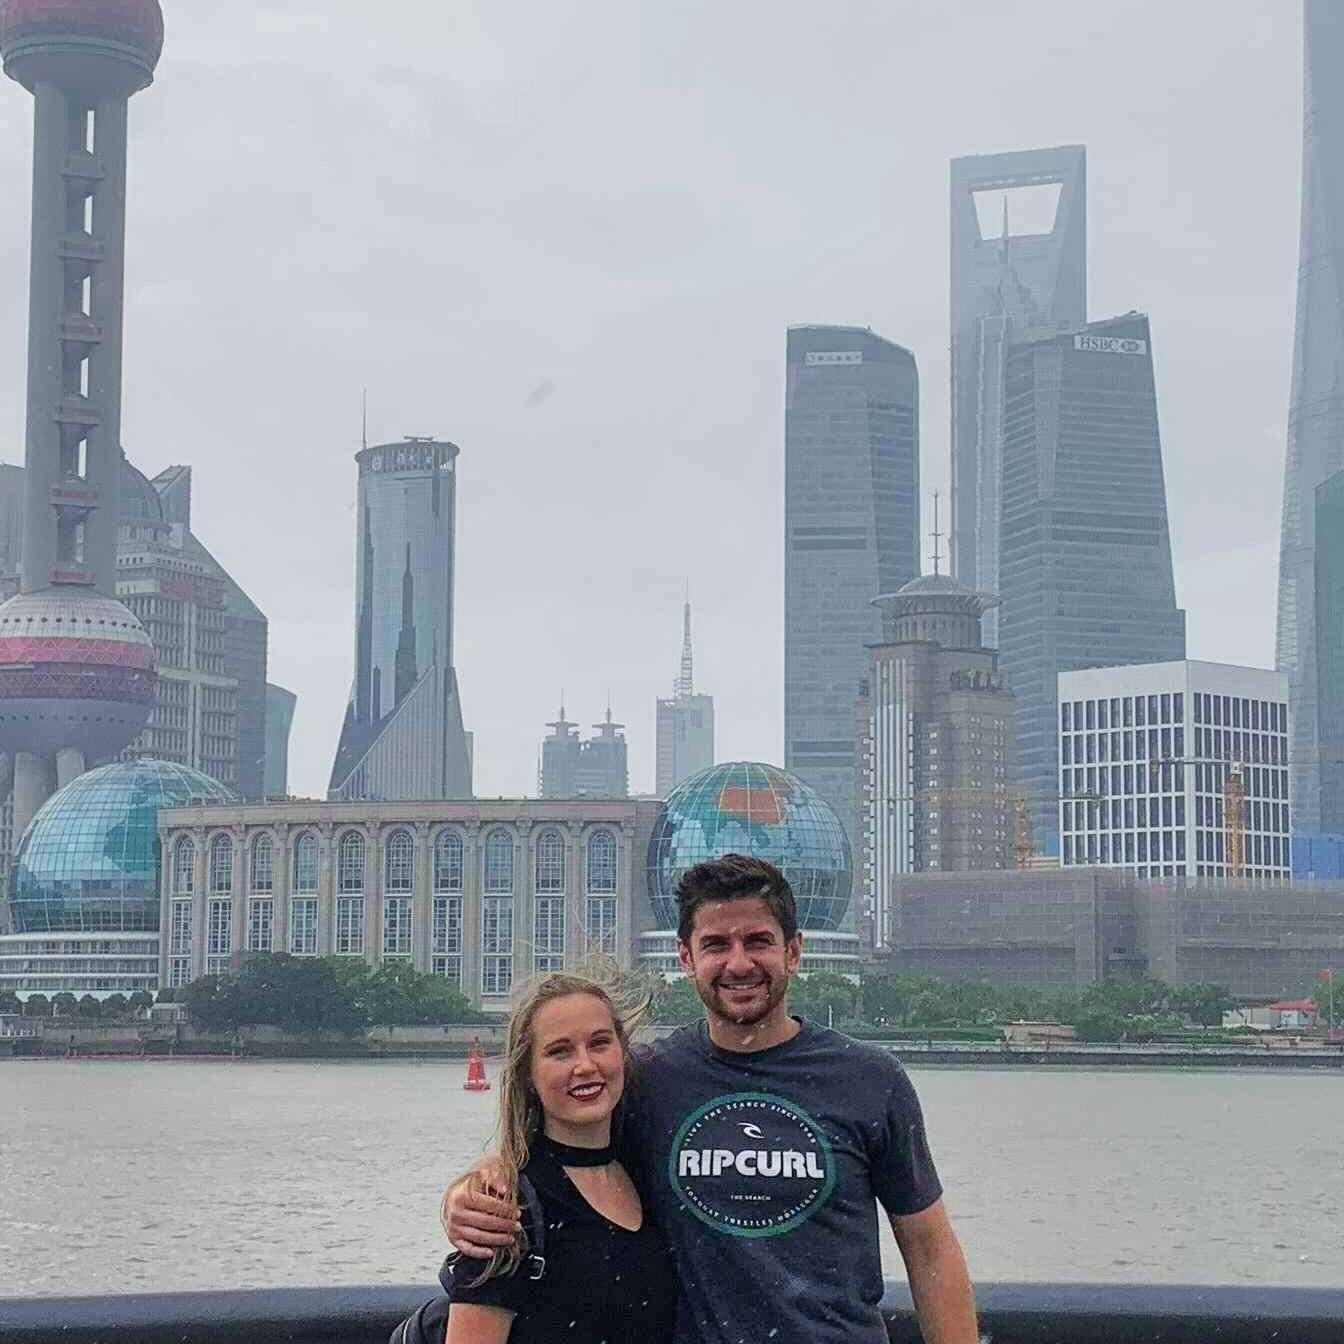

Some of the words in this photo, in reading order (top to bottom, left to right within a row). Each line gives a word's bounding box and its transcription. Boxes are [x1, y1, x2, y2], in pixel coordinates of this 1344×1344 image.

[1080, 337, 1120, 353] HSBC
[704, 1108, 722, 1121] THE
[726, 1101, 767, 1111] SEARCH
[770, 1104, 798, 1121] SINCE
